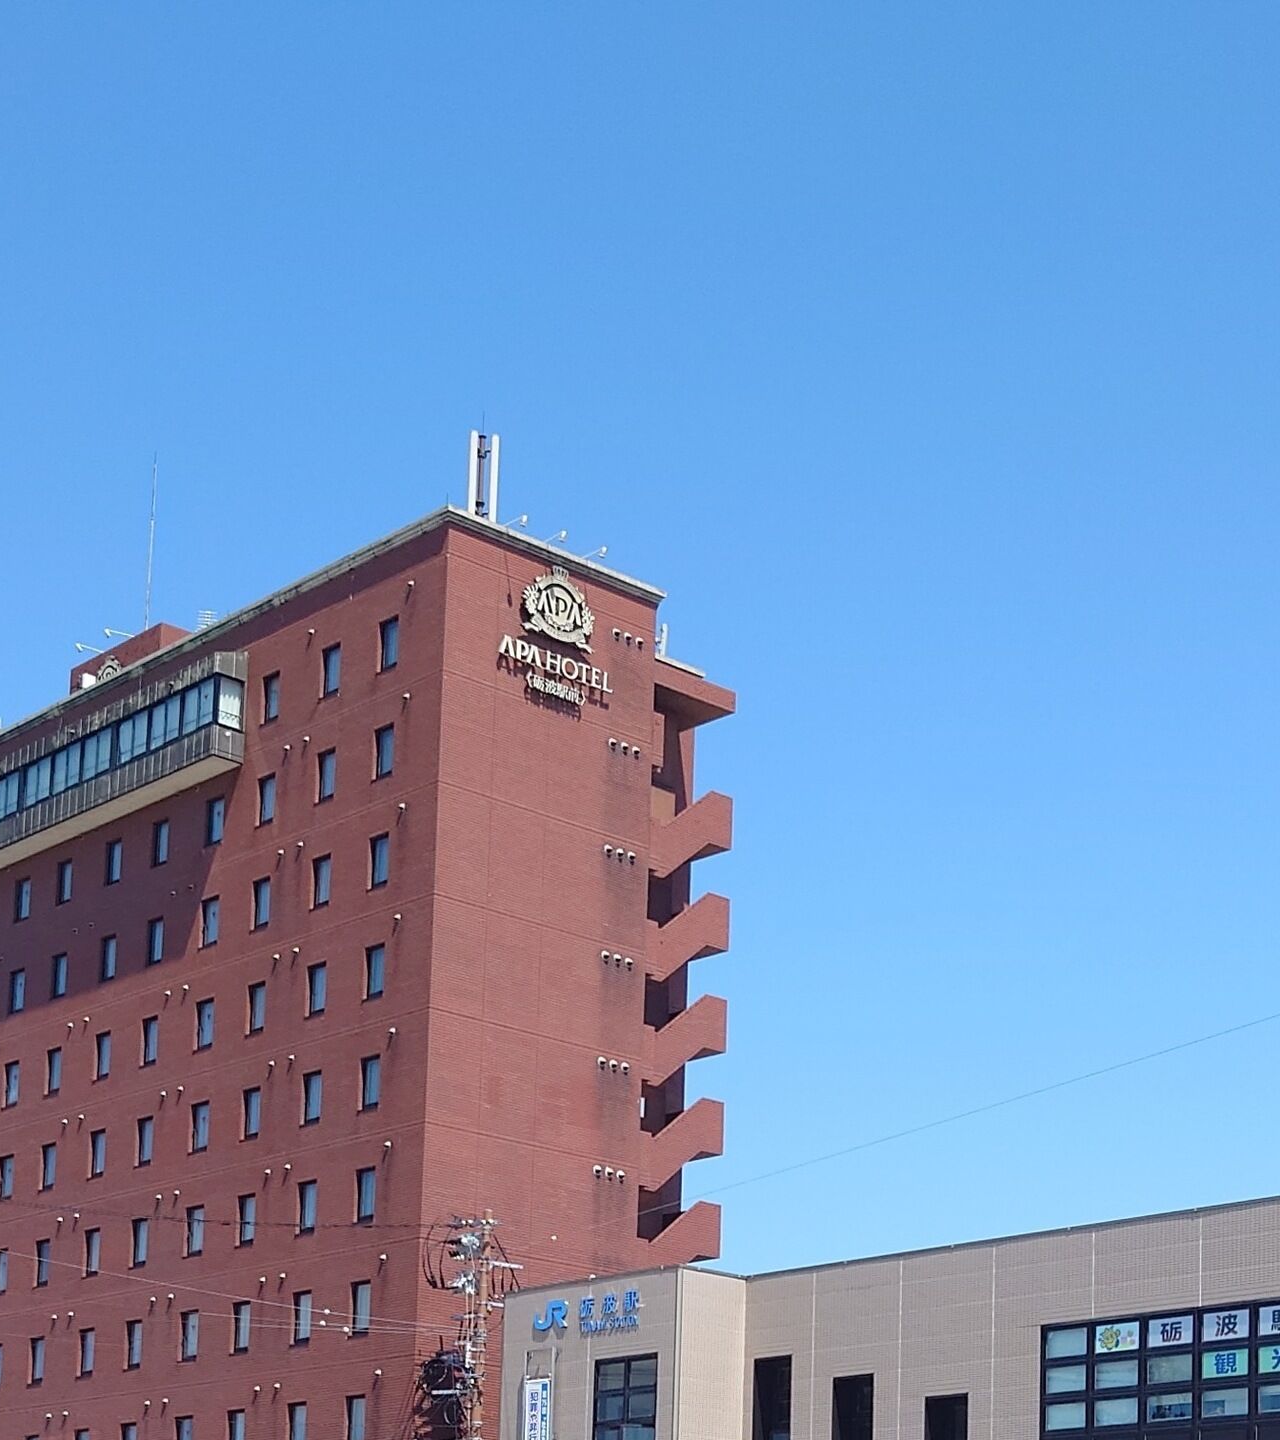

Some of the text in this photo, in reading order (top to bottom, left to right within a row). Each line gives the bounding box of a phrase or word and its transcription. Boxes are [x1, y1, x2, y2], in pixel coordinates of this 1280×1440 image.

[538, 589, 582, 626] APA
[499, 634, 543, 669] APA
[545, 650, 613, 693] HOTEL
[534, 1299, 568, 1331] JR
